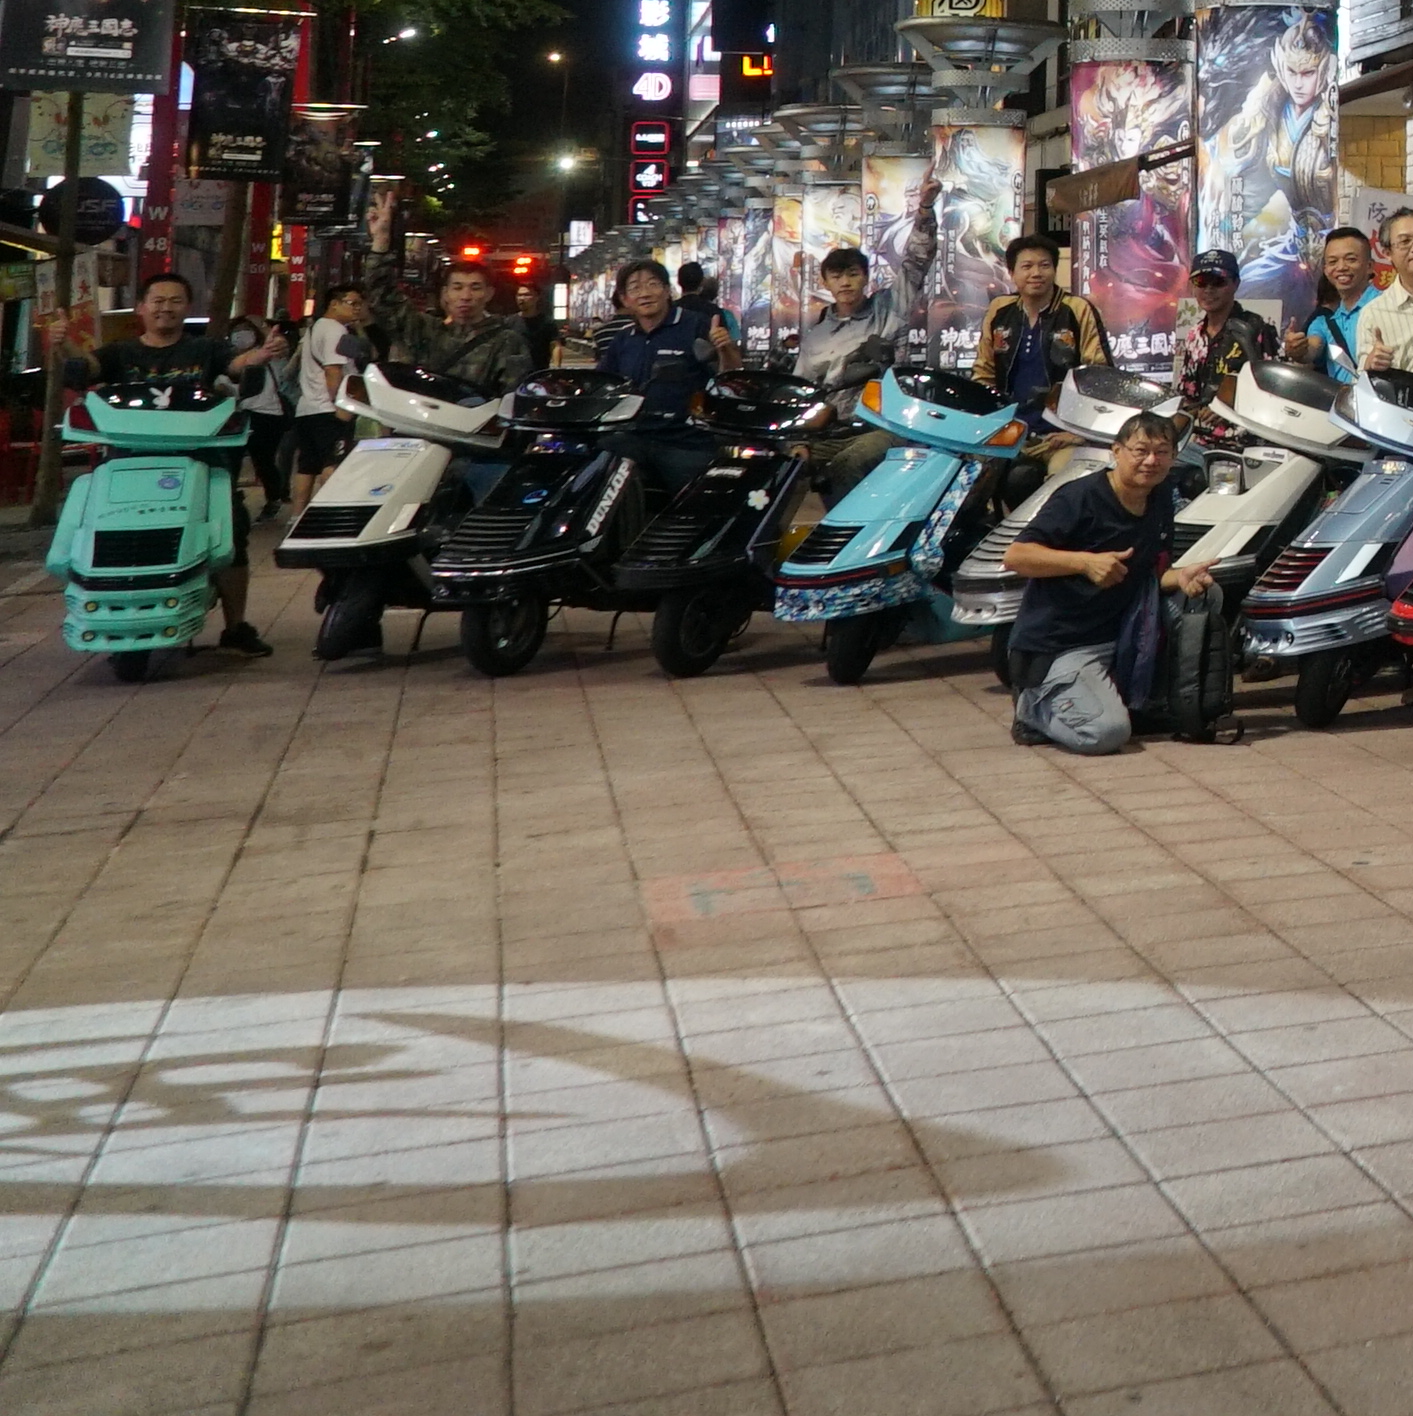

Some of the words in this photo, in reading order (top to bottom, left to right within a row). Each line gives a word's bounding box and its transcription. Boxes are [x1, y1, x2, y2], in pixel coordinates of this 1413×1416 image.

[632, 71, 672, 101] 4D
[148, 205, 169, 221] W
[144, 236, 168, 252] 48
[291, 255, 305, 265] W
[290, 272, 305, 282] 52
[585, 457, 632, 536] DUNLOP
